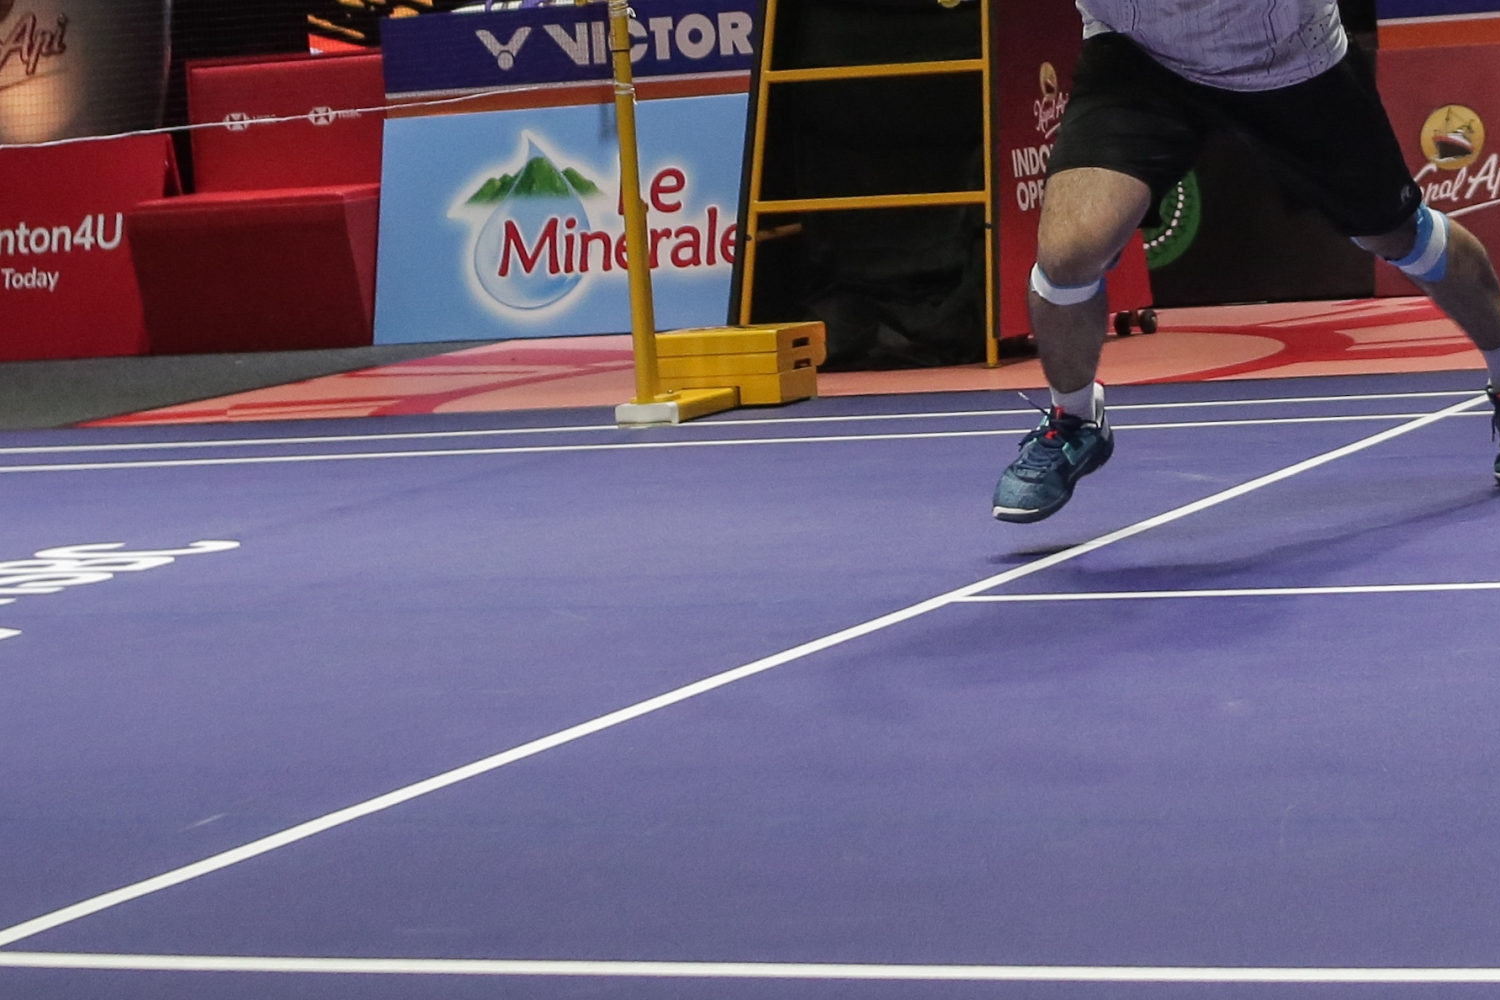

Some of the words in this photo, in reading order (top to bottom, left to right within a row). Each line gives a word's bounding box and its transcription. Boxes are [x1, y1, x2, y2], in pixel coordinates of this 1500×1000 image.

[543, 11, 754, 66] VICTOR
[1012, 144, 1054, 178] INDO
[1016, 179, 1045, 211] OPE
[0, 211, 123, 256] nton4U
[1, 266, 59, 293] Today
